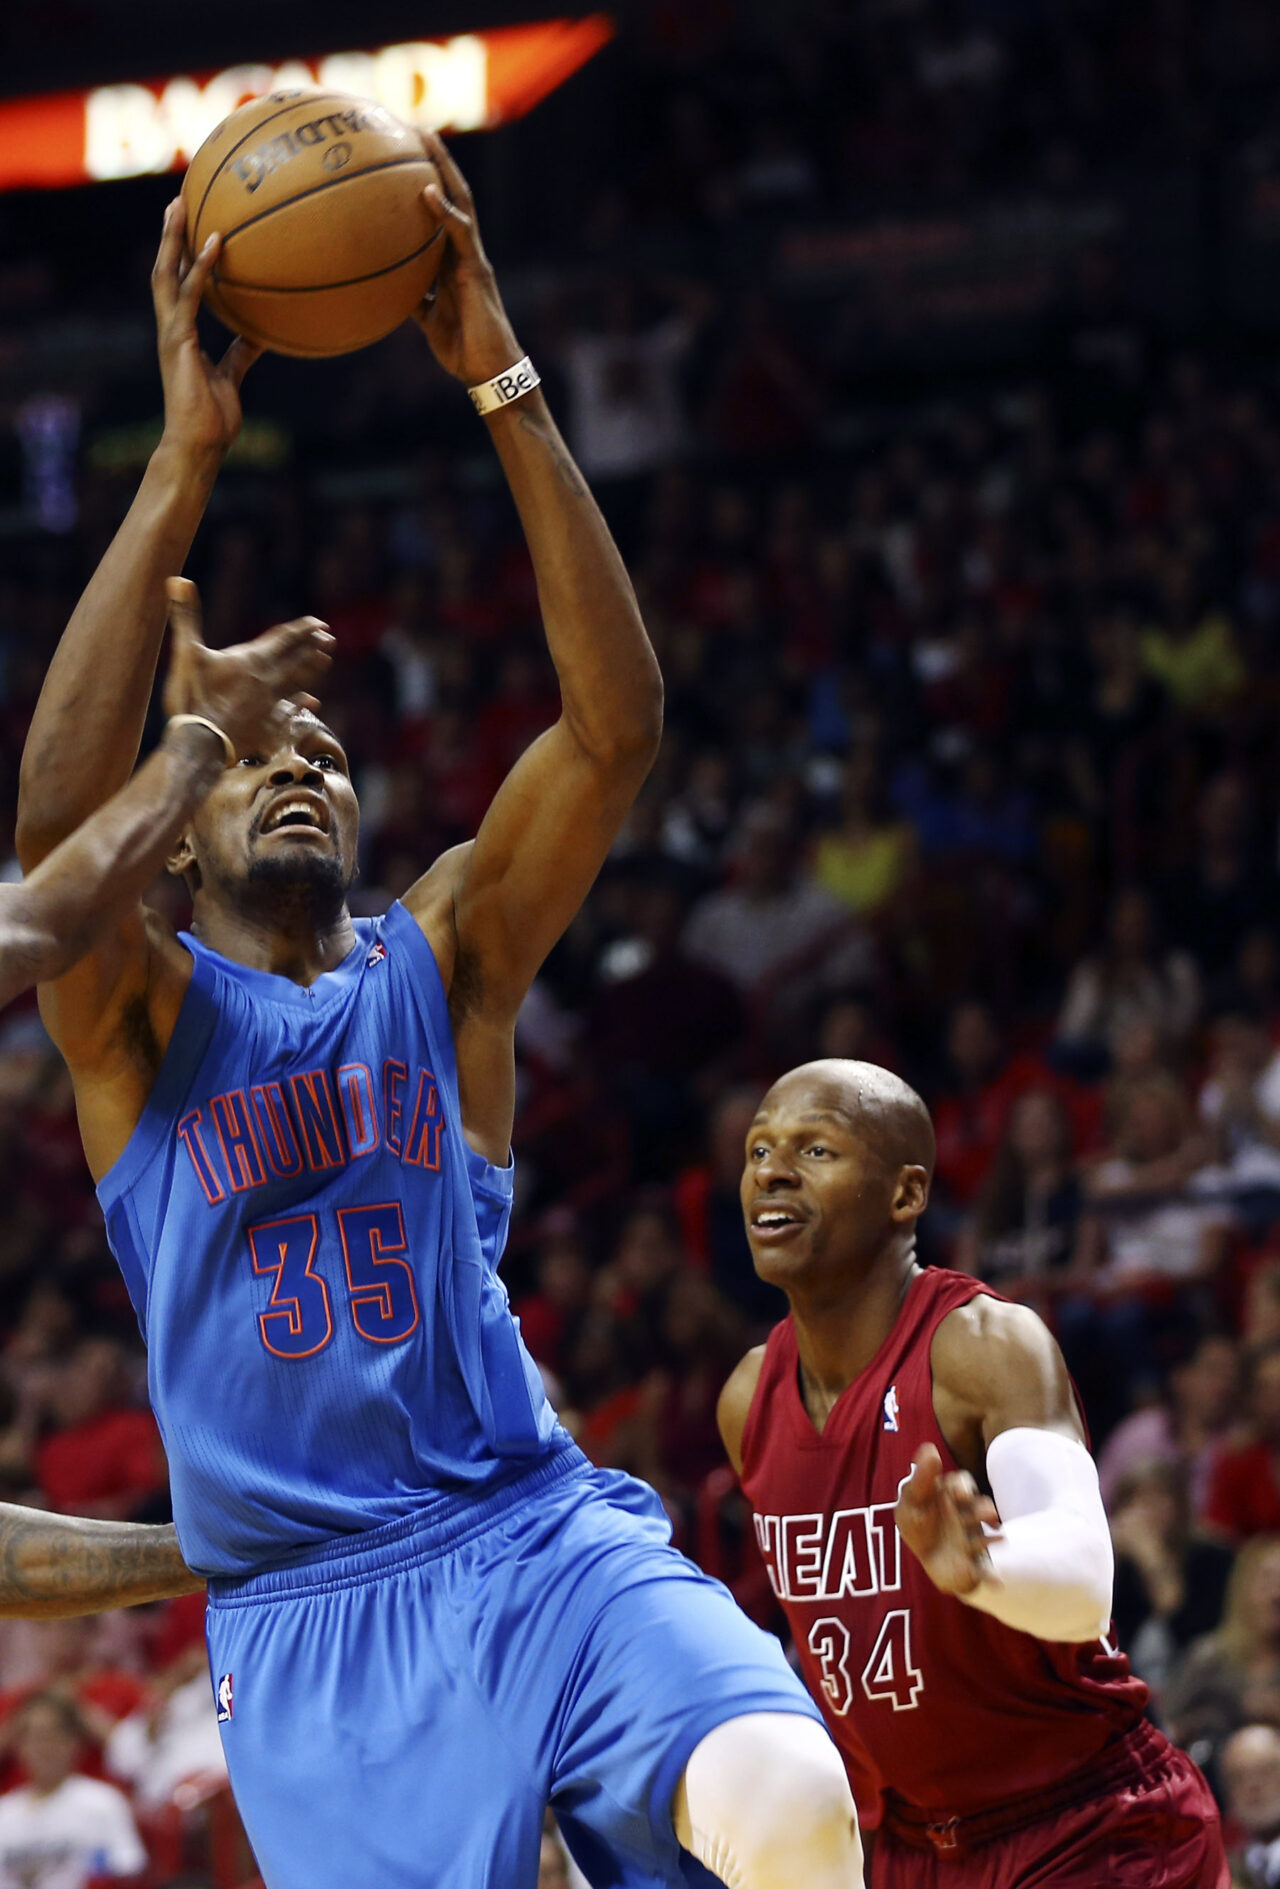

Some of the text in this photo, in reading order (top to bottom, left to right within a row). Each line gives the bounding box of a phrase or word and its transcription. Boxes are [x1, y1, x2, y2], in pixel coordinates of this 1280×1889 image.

[226, 108, 370, 194] ALDING
[177, 1058, 448, 1206] THUNDER
[247, 1201, 420, 1361] 35
[753, 1501, 904, 1602] HEAT
[808, 1608, 924, 1717] 34
